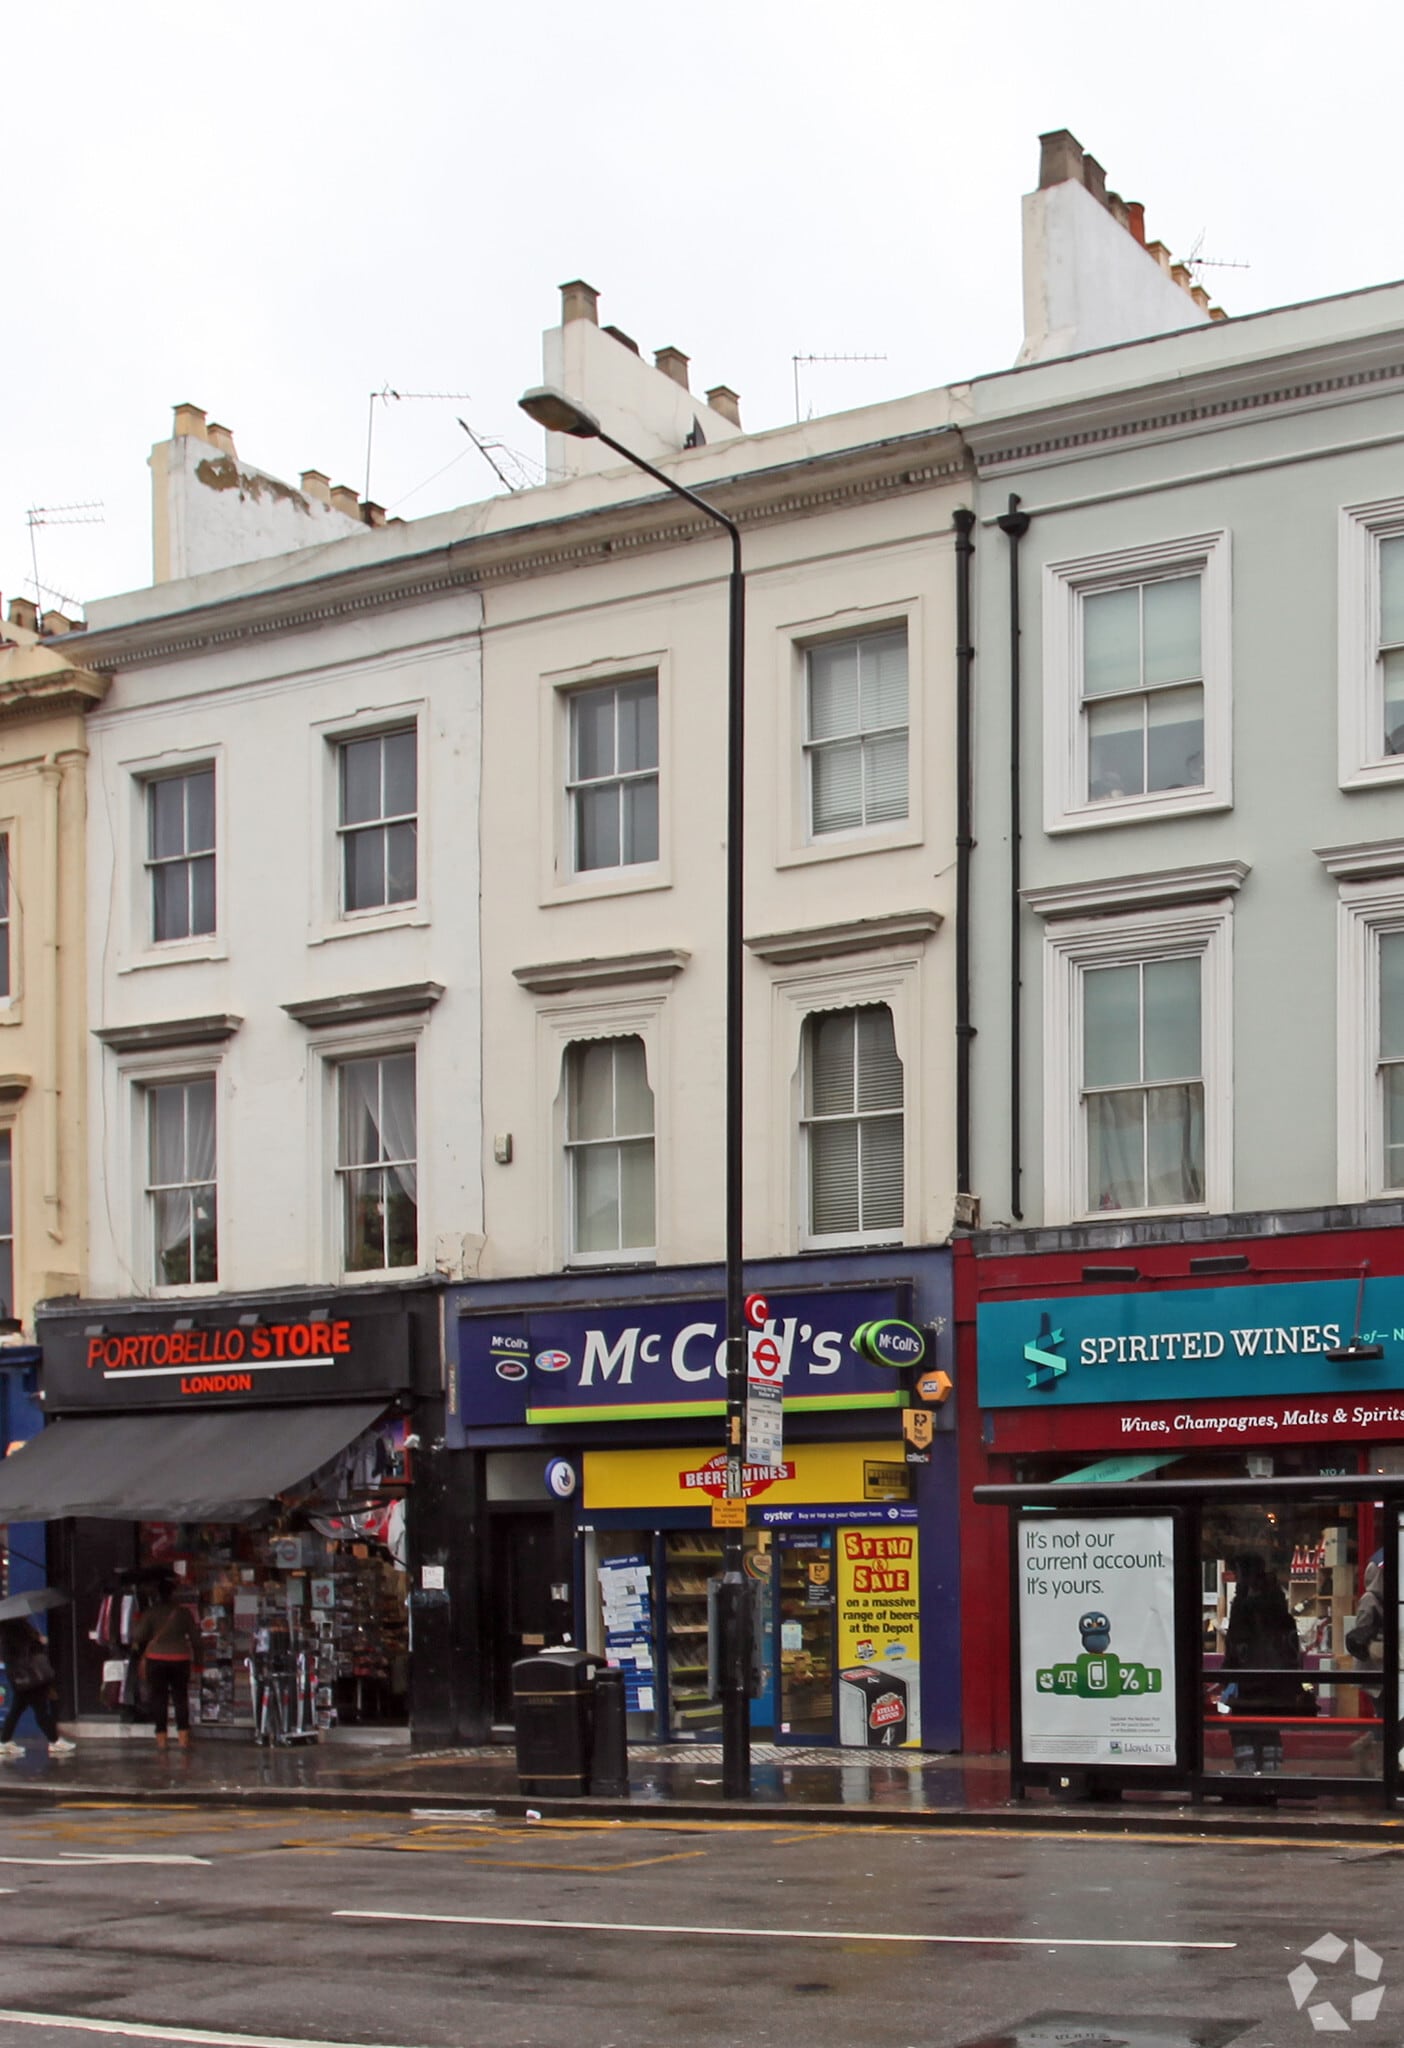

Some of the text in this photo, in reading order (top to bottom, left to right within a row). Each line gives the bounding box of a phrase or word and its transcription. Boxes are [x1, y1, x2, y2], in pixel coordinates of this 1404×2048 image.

[751, 1299, 767, 1324] C
[87, 1321, 350, 1368] PORTOBELLO STORE
[578, 1317, 843, 1386] McCl's
[879, 1333, 920, 1353] McColl's
[1080, 1323, 1341, 1365] SPIRITED WINES
[181, 1374, 252, 1394] LONDON
[1121, 1407, 1404, 1433] Wines, Champagnes, Malts & Spirits
[763, 1511, 794, 1522] oyster
[846, 1535, 910, 1556] SPEND
[1026, 1530, 1115, 1548] It's not our
[1026, 1550, 1166, 1570] current account.
[855, 1568, 906, 1589] SAVE
[1026, 1577, 1104, 1599] It's yours.
[846, 1597, 916, 1607] on a massive
[843, 1610, 920, 1622] range of beers
[849, 1623, 914, 1635] at the Depot
[1124, 1743, 1152, 1755] Lloyds
